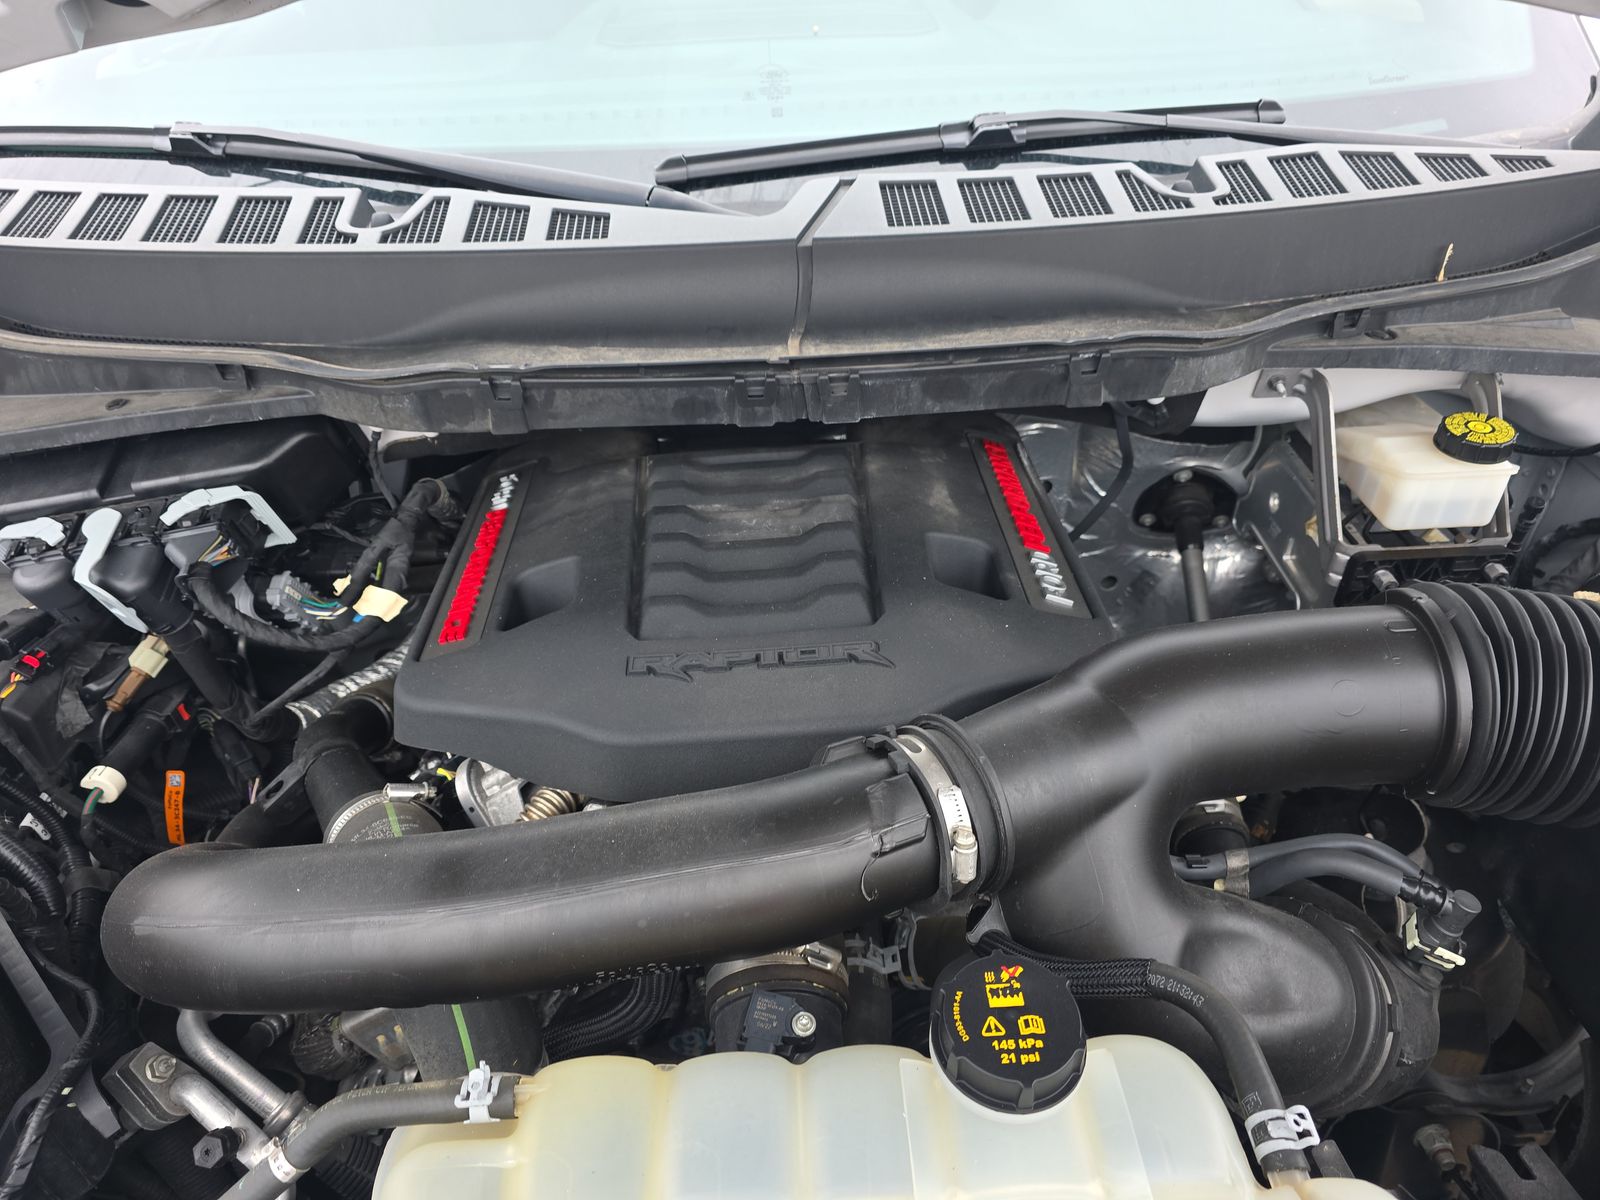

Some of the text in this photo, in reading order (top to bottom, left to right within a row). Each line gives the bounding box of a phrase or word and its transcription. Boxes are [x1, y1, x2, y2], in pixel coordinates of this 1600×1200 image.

[626, 641, 896, 683] RAPTOR
[992, 1038, 1044, 1051] 145 kPa
[1001, 1053, 1040, 1065] 21 psi
